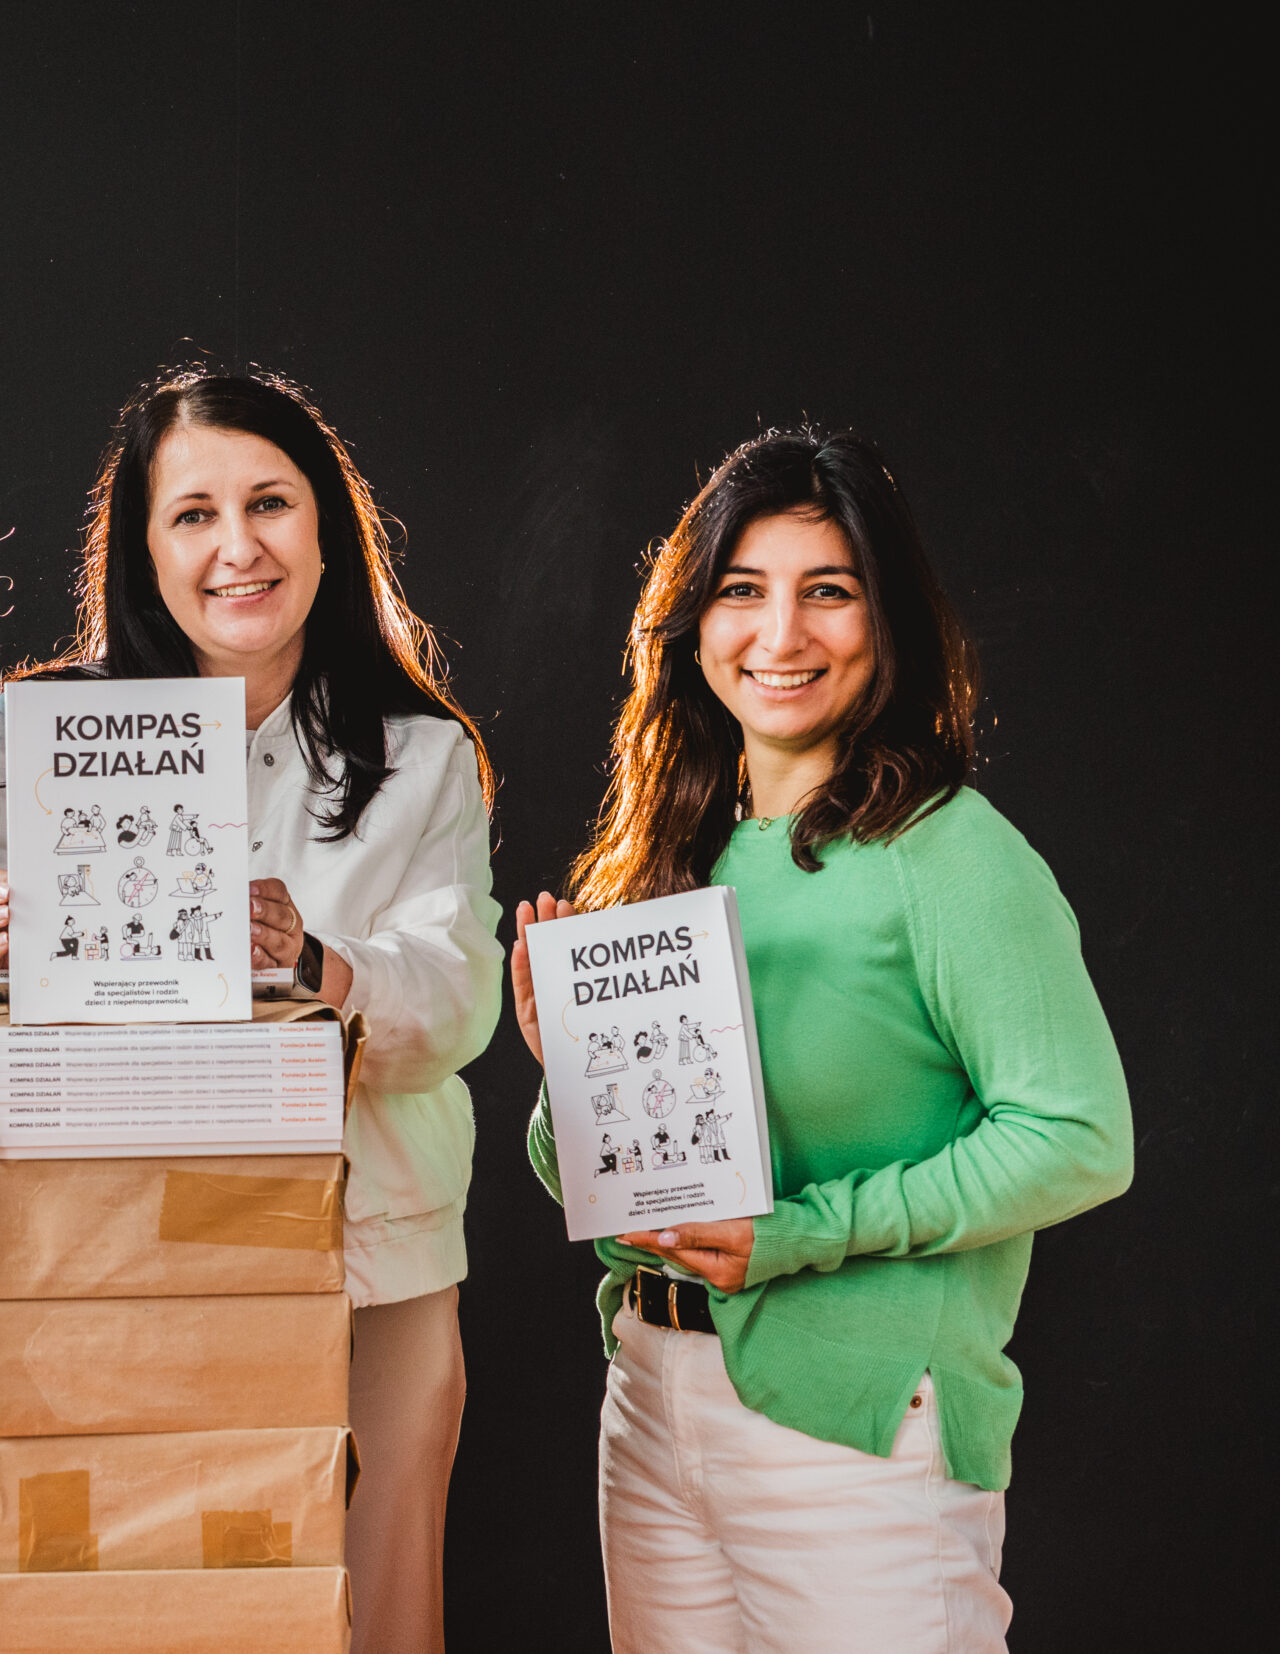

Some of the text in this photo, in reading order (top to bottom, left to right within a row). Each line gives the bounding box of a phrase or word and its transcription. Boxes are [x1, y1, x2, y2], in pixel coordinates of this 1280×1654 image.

[55, 712, 201, 741] KOMPAS
[53, 743, 204, 778] DZIAŁAŃ
[571, 926, 693, 972] KOMPAS
[573, 953, 700, 1006] DZIAŁAŃ
